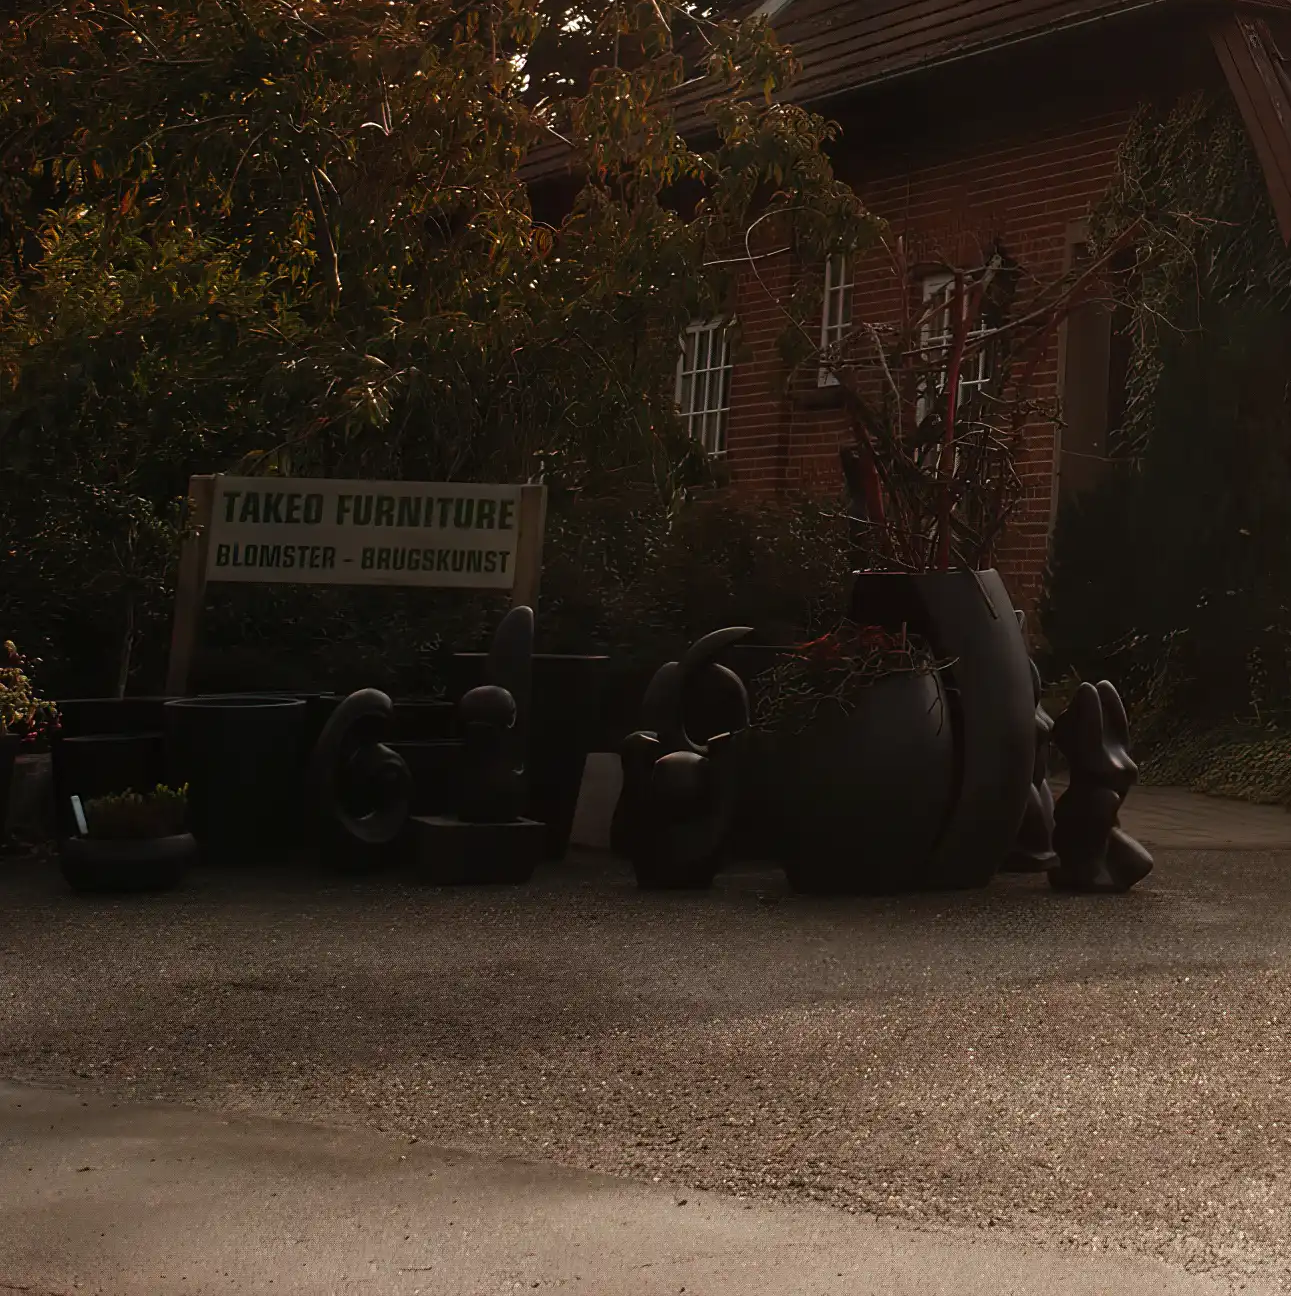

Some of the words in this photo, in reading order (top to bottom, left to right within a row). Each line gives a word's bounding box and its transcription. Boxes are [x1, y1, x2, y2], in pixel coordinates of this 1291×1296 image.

[222, 490, 324, 524] TAKEO
[336, 493, 515, 530] FURNITURE
[215, 543, 336, 569] BLOMSTER
[360, 547, 511, 574] BRUGSKUNST
